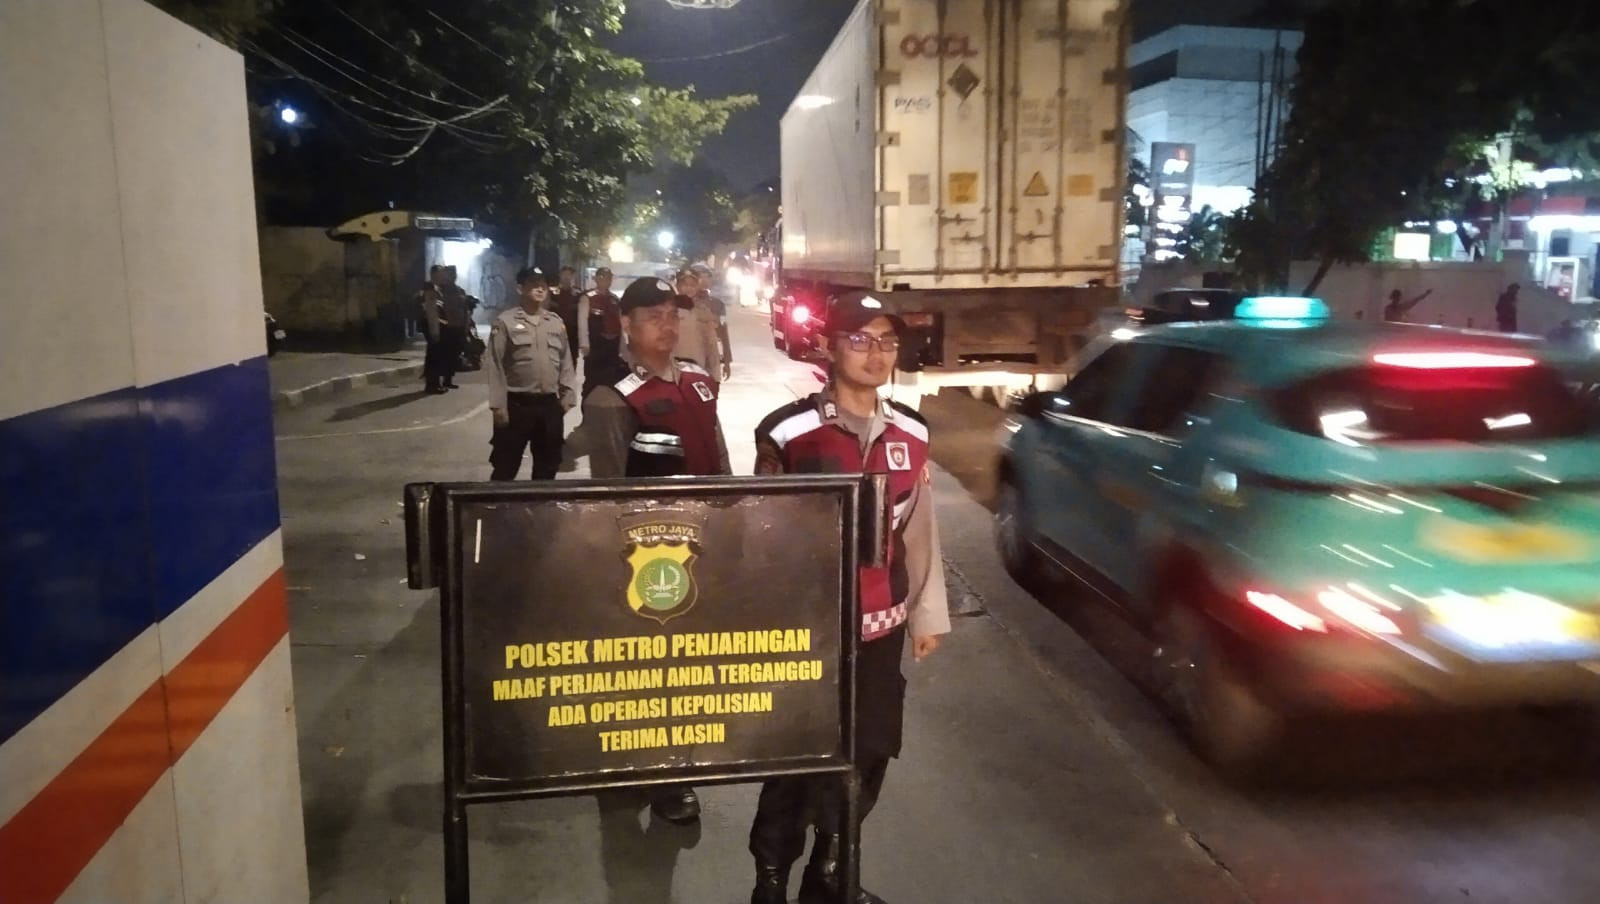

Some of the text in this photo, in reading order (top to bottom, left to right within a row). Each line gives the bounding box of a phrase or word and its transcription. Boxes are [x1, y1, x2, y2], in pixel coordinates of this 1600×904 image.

[628, 525, 694, 538] METRO JAYA
[505, 629, 811, 669] POLSEK METRO PENJARINGAN
[493, 660, 823, 701] MAAF PERJALANAN ANDA TERGANGGU
[548, 692, 773, 727] ADA OPERASI KEPOLISIAN
[600, 723, 725, 752] TERIMA KASIH
